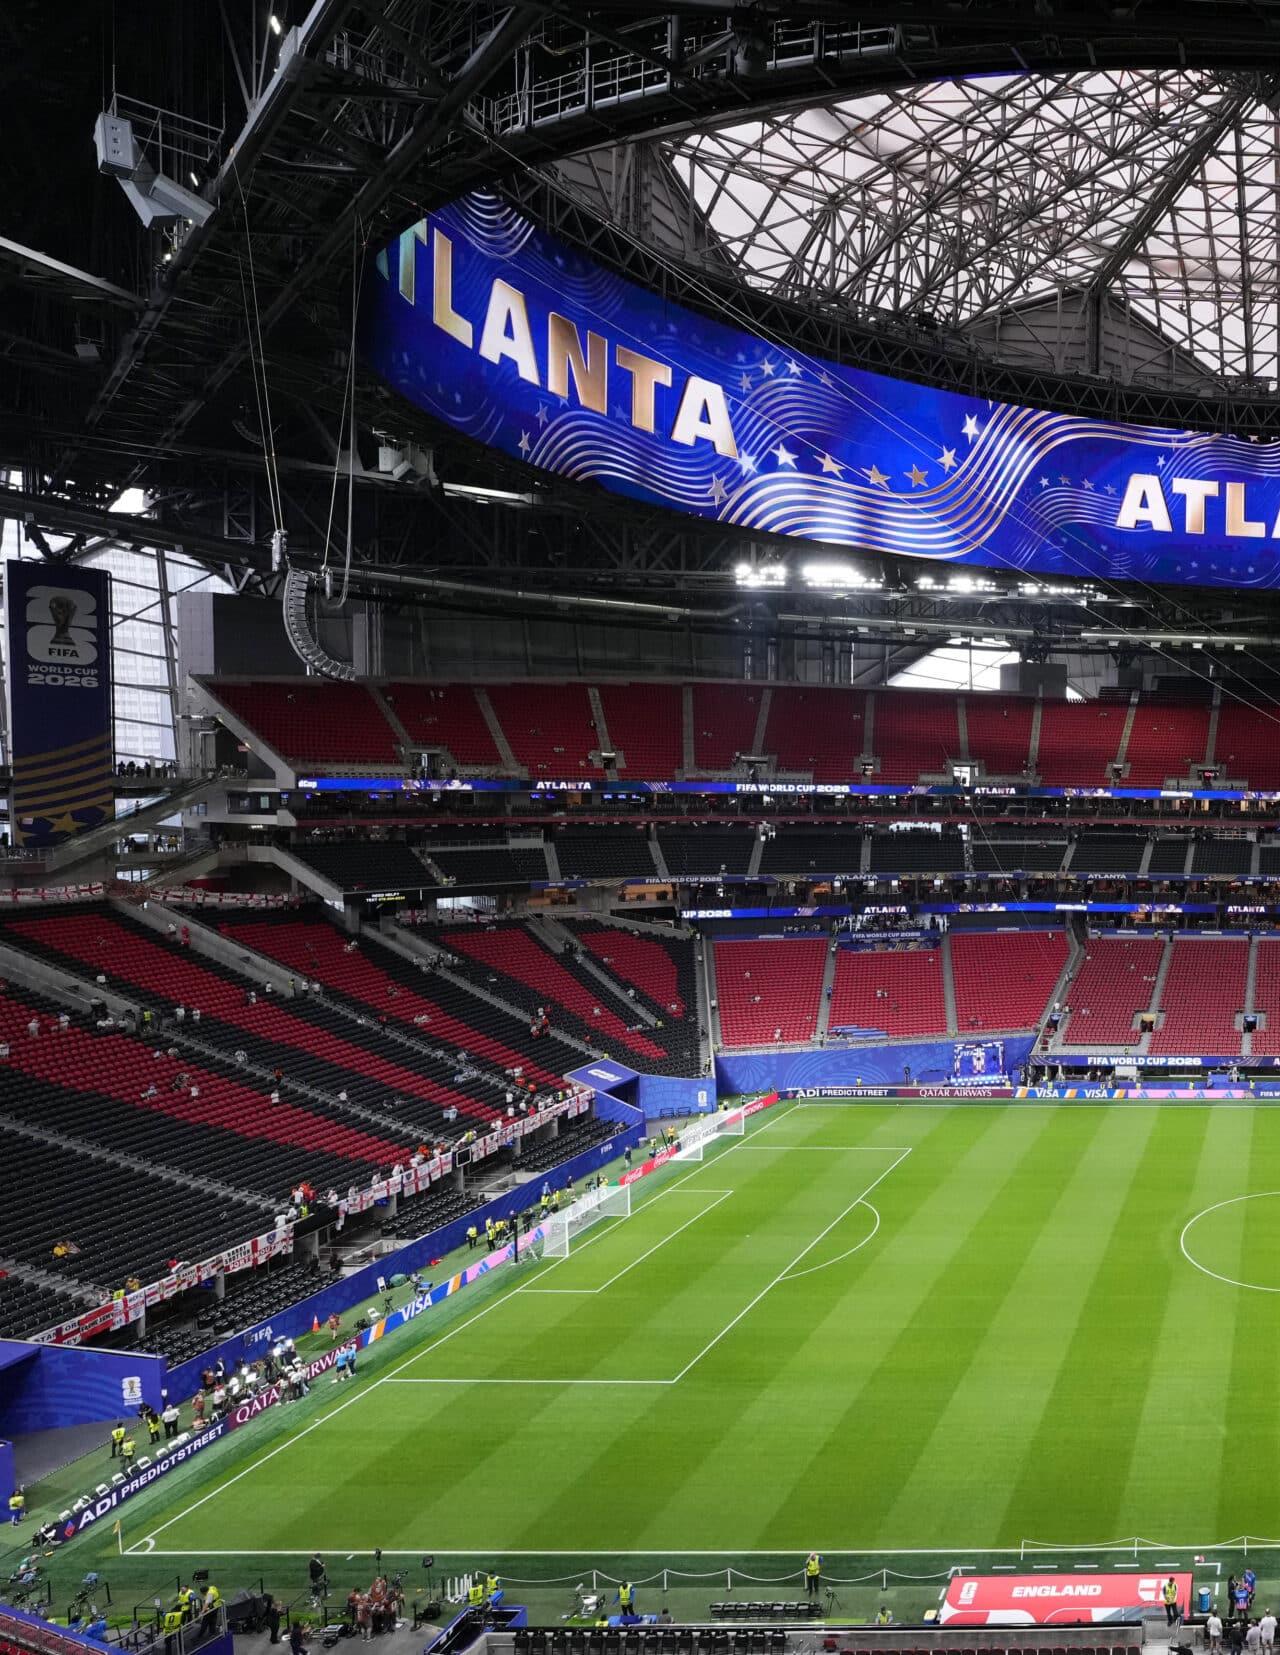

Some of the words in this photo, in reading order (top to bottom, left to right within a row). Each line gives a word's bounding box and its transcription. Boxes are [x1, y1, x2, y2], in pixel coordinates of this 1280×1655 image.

[377, 217, 738, 459] TLANTA
[48, 648, 80, 658] FIFA
[27, 664, 73, 674] WORLD
[74, 667, 98, 676] CUP
[27, 673, 99, 688] 2026
[536, 782, 592, 790] ATLANTA
[736, 784, 757, 792] FIFA
[758, 784, 795, 793] WORLD
[796, 784, 816, 793] CUP
[817, 785, 850, 793] 2026
[974, 787, 1016, 795] ATLANTA
[697, 910, 732, 918] 2026
[1088, 1056, 1111, 1065] FIFA
[1112, 1056, 1145, 1065] WORLD
[1146, 1056, 1166, 1065] CUP
[1167, 1057, 1202, 1065] 2026
[796, 1089, 820, 1098] ADI
[919, 1089, 952, 1097] QATAR
[953, 1089, 992, 1097] AIRWAYS
[1035, 1089, 1059, 1098] VISA
[1084, 1089, 1108, 1098] VISA
[401, 1293, 433, 1322] VISA
[236, 1387, 280, 1423] QATA
[78, 1493, 118, 1530] ADI
[121, 1423, 224, 1499] PREDICTSTREET
[1011, 1585, 1102, 1598] ENGLAND
